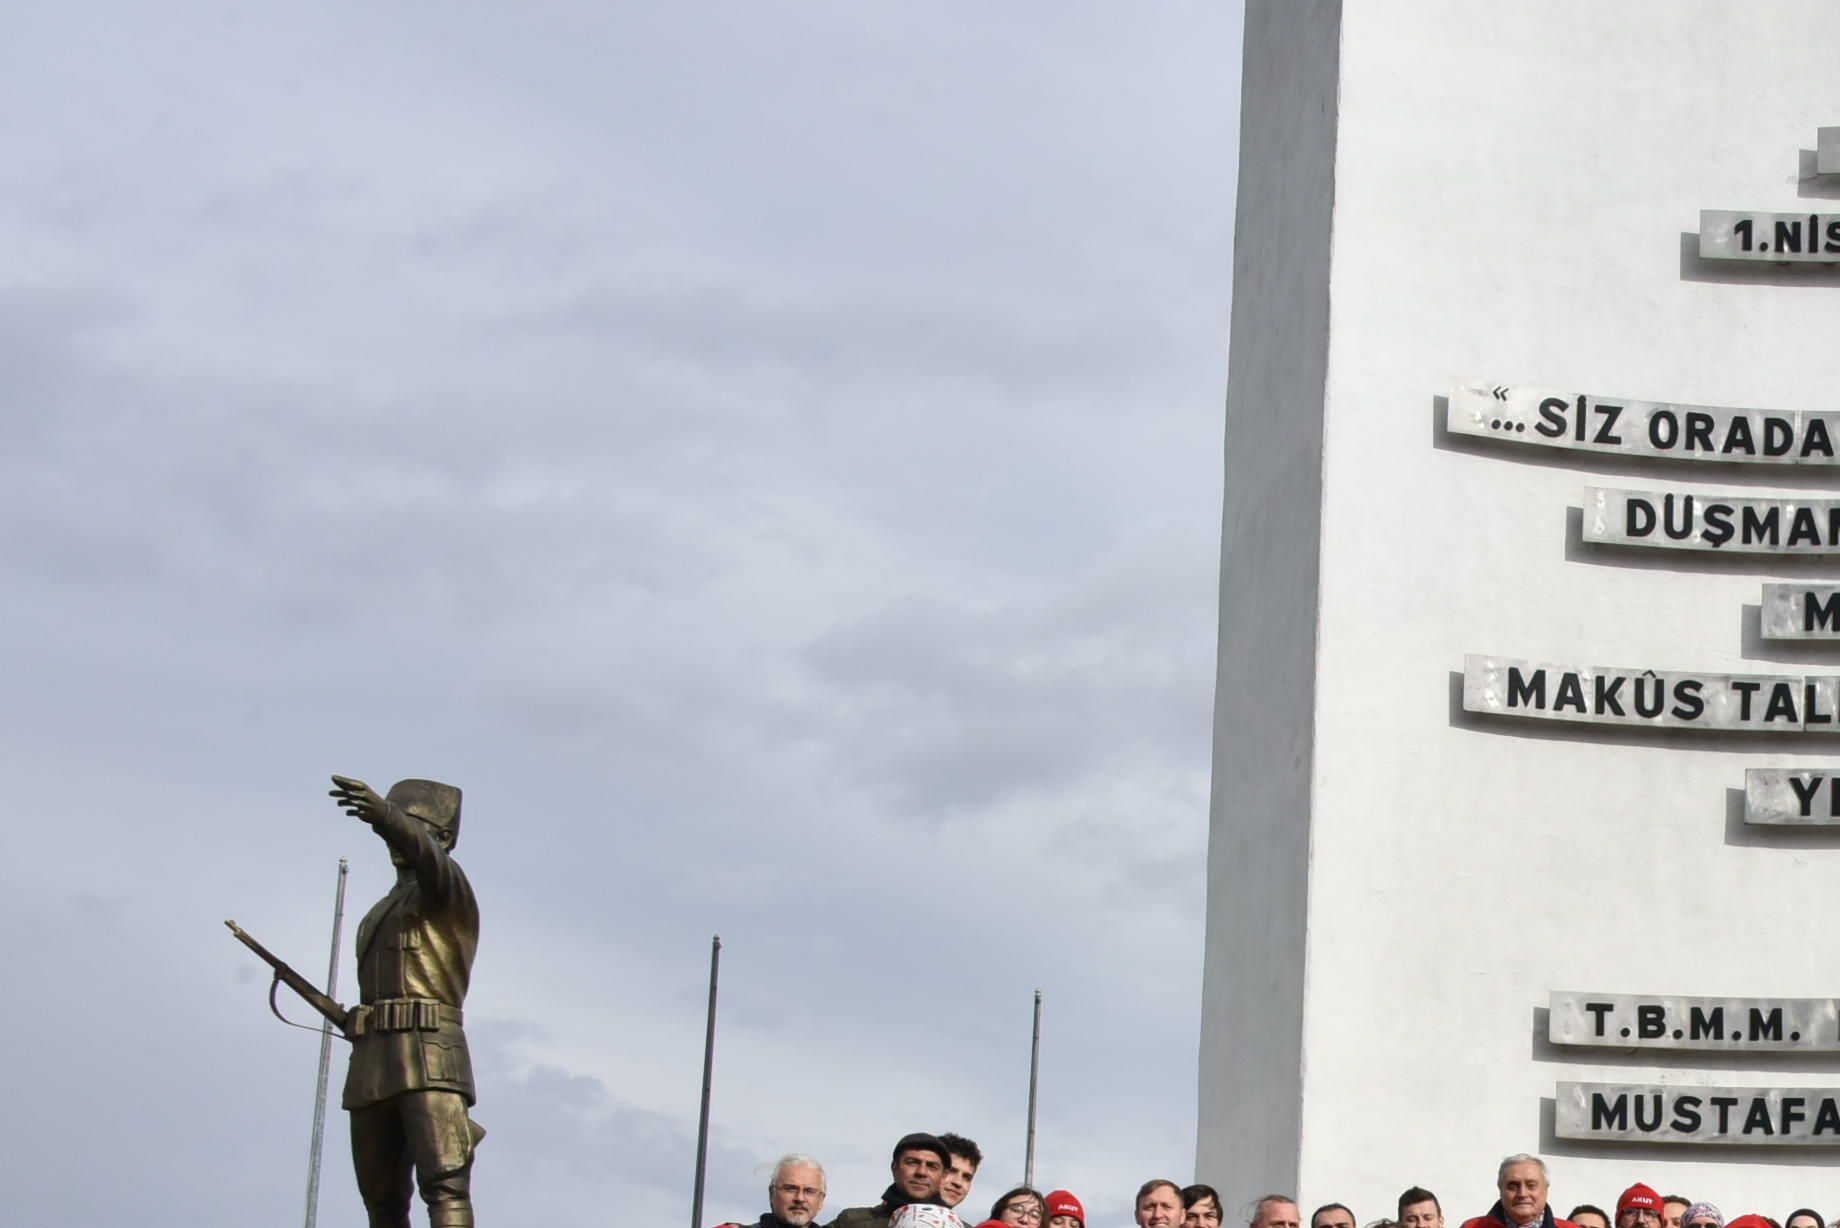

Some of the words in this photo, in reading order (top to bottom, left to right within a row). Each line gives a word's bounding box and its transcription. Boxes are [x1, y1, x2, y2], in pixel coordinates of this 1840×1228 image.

[1648, 410, 1835, 457] ORADA
[1506, 665, 1706, 722] MAKÛS
[1585, 1002, 1801, 1044] T.B.M.M.
[1058, 1203, 1080, 1212] AKUT
[1631, 1196, 1654, 1205] AKUT
